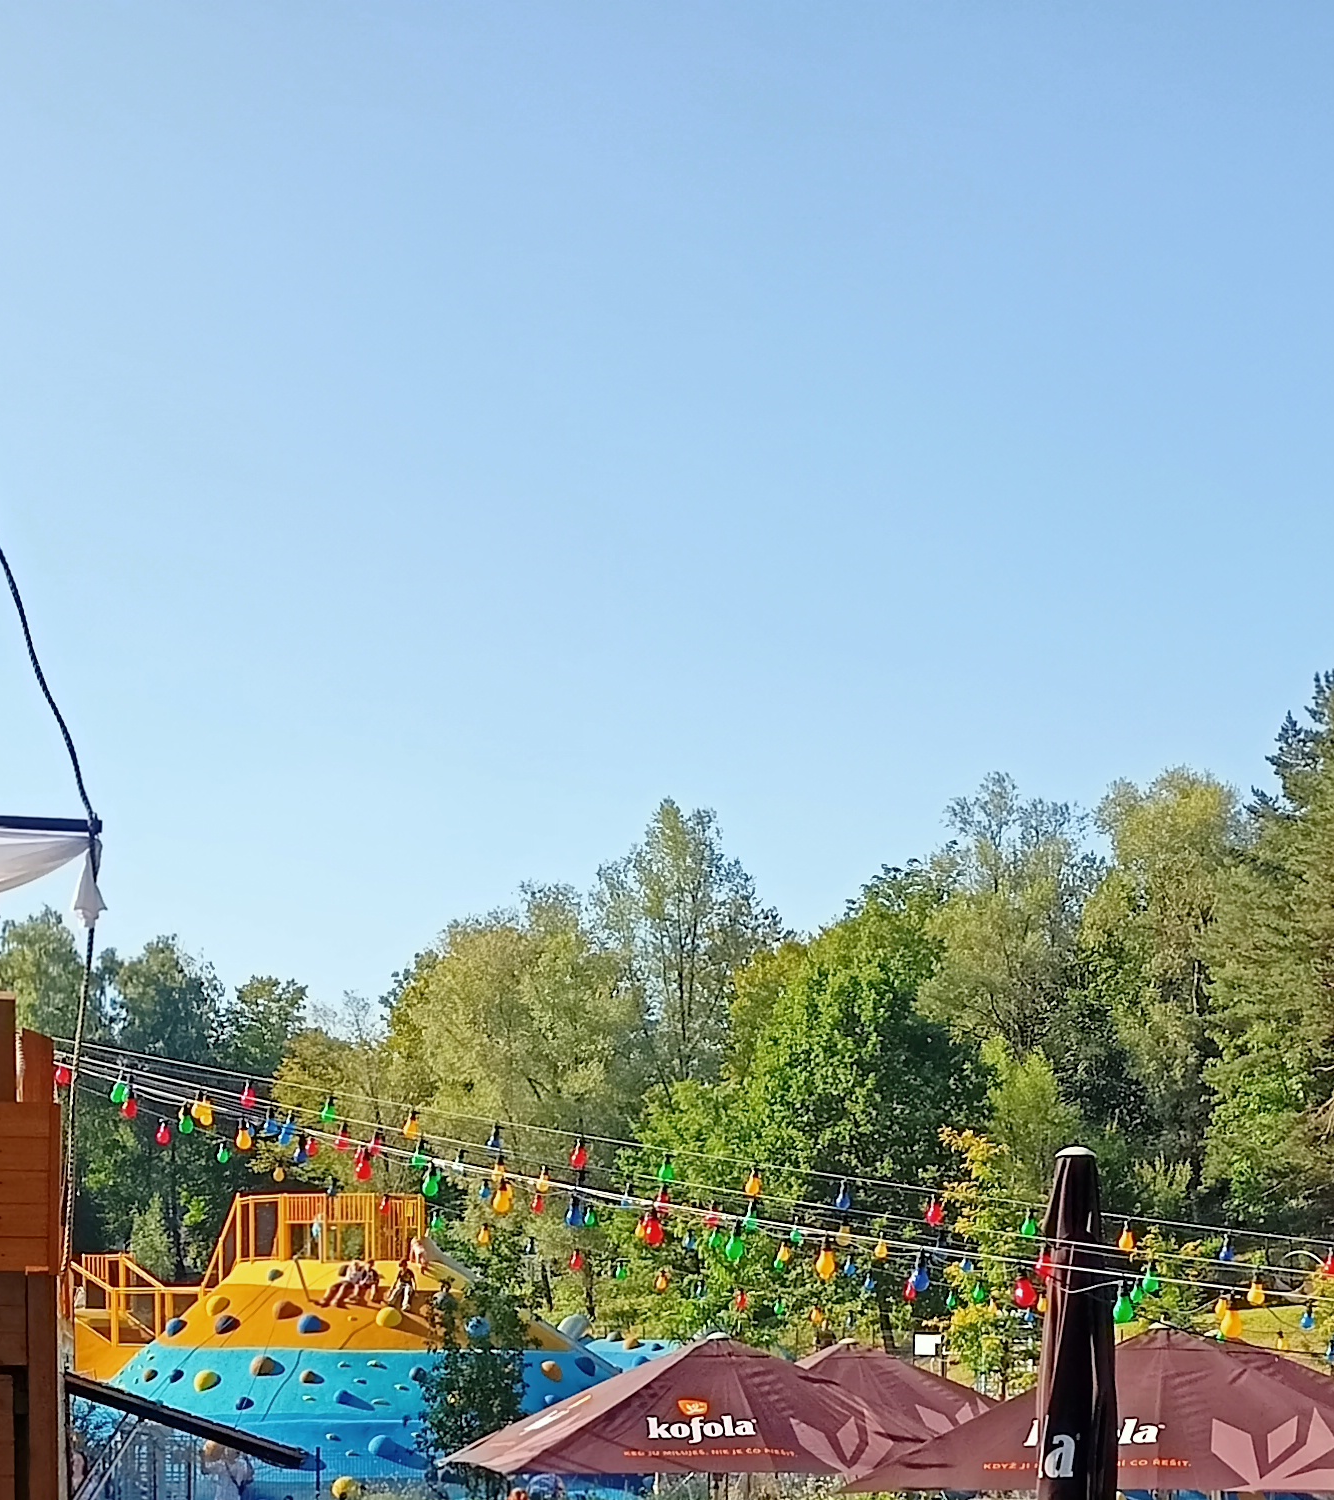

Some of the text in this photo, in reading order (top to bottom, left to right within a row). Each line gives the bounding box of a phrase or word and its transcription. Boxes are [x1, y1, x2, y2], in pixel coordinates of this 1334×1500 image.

[646, 1415, 757, 1444] kofola
[983, 1462, 1016, 1470] KDYŽ
[1130, 1459, 1148, 1467] CO
